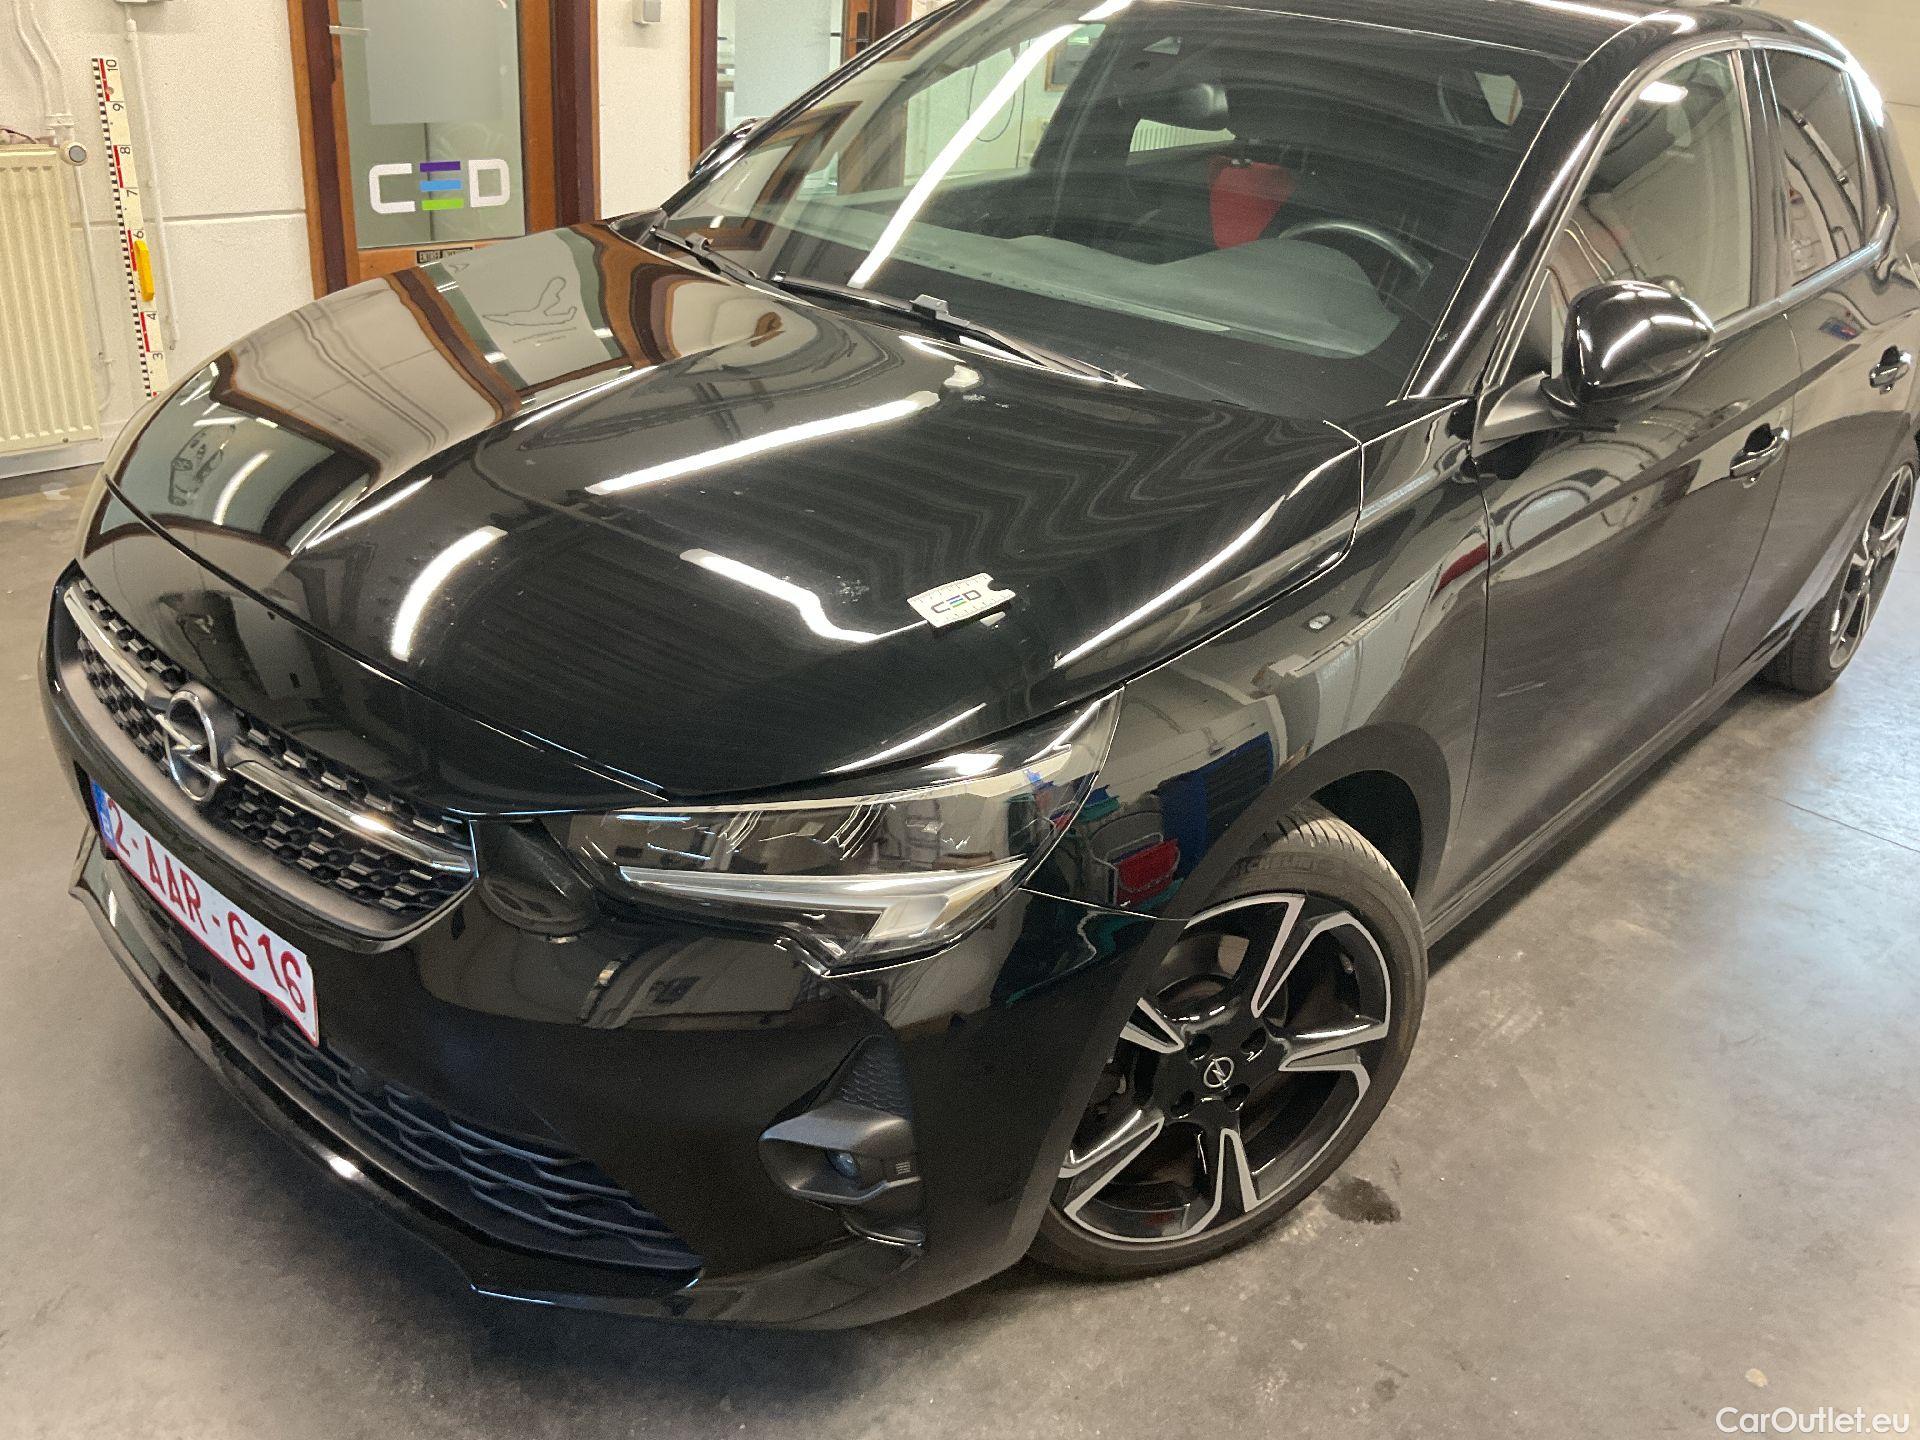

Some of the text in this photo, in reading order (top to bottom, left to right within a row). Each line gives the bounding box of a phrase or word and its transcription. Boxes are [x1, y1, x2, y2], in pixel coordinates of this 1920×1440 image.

[106, 59, 118, 72] 10
[112, 103, 124, 112] 9
[120, 146, 131, 155] 8
[369, 159, 511, 214] CED
[126, 189, 138, 198] 7
[146, 313, 157, 321] 4
[152, 352, 164, 361] 3
[931, 589, 982, 614] CED
